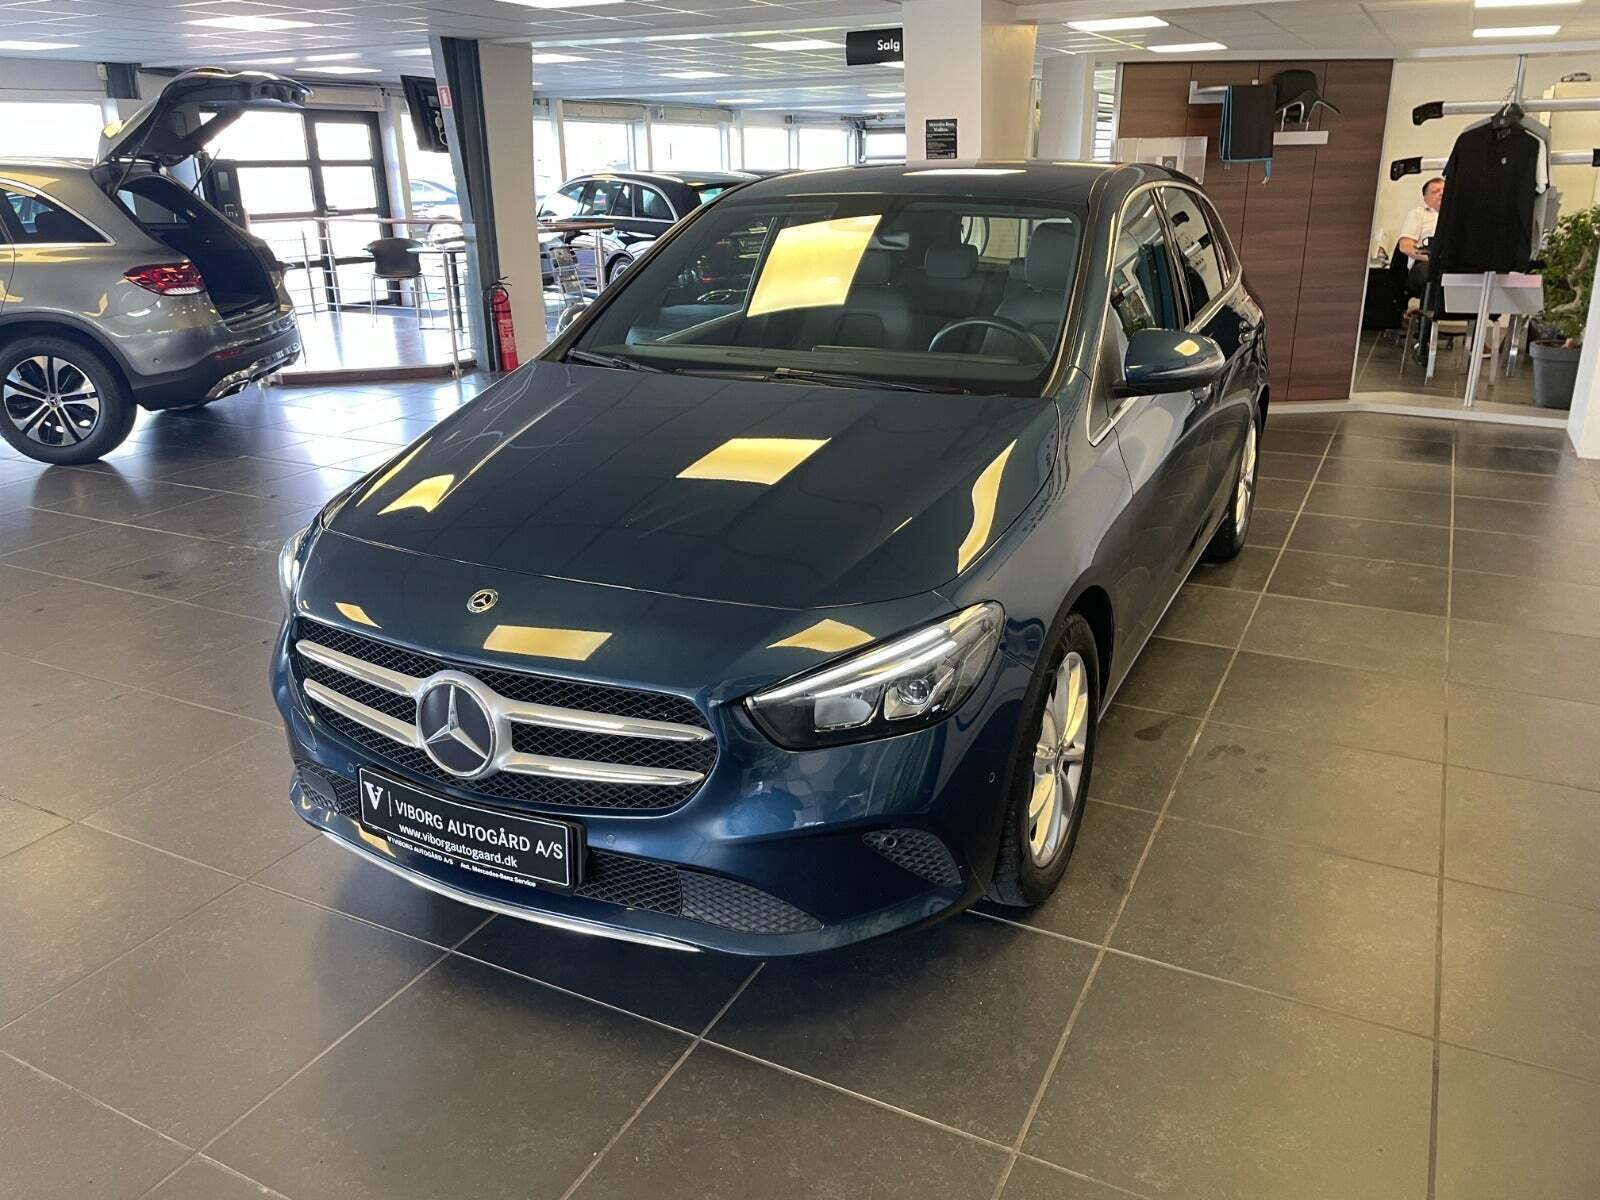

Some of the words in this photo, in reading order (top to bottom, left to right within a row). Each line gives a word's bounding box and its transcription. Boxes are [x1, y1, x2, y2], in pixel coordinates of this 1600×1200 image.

[877, 38, 901, 52] Salg
[394, 799, 444, 829] VIBORG
[447, 818, 531, 852] AUTOGÅRD
[535, 840, 563, 860] A/S
[399, 823, 518, 868] www.viborgautogaard.dk
[443, 857, 454, 865] A/S
[472, 865, 514, 882] Mercedes-Benz
[514, 876, 537, 887] Service
